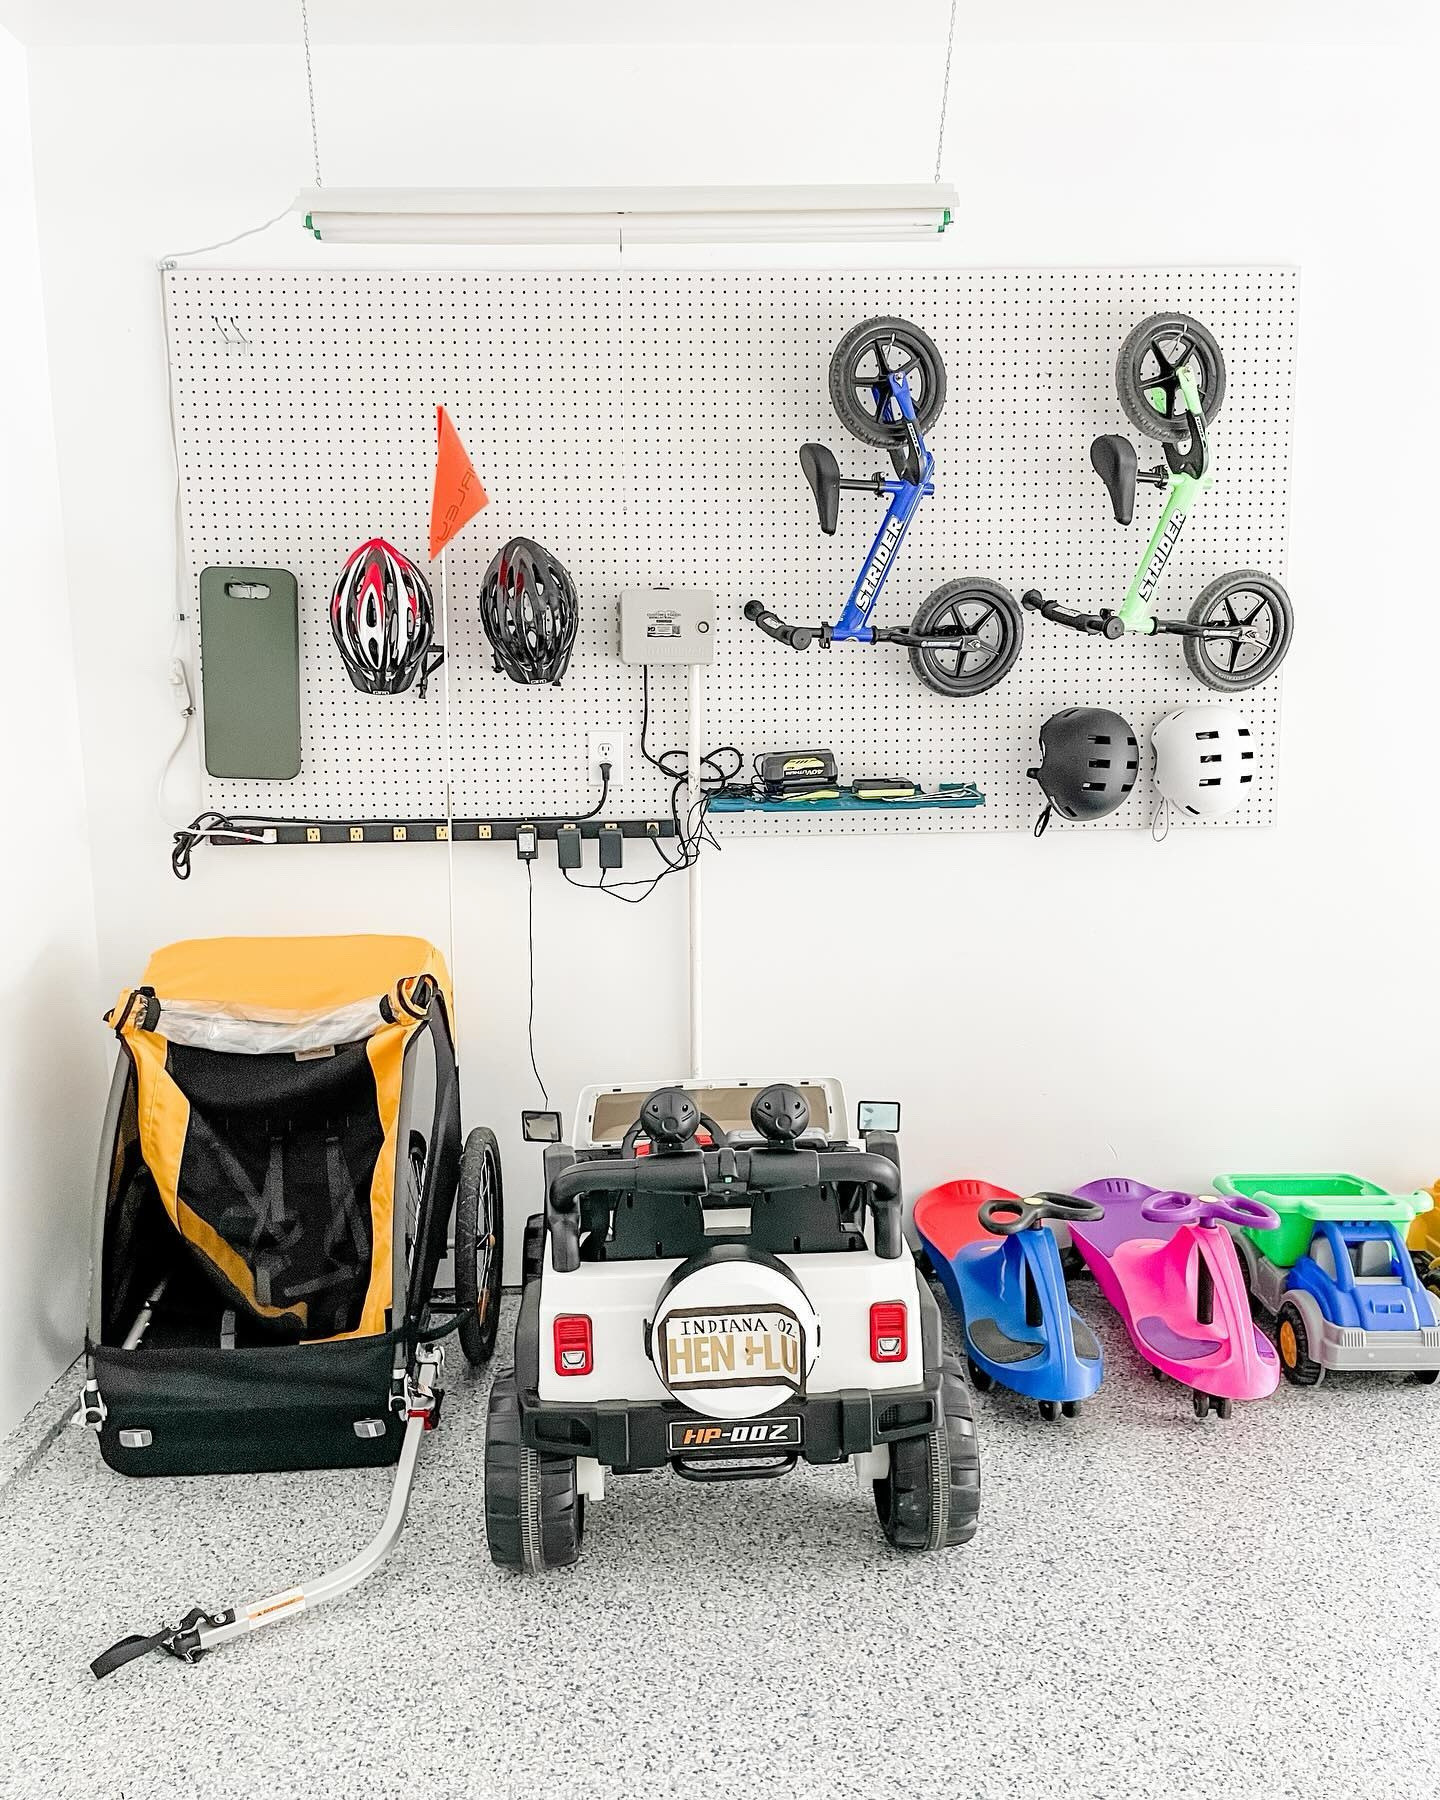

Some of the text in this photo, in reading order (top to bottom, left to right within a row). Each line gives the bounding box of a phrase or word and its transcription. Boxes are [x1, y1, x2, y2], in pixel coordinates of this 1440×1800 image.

[855, 515, 904, 613] STRIDER
[1138, 508, 1186, 602] STRIDER
[681, 1318, 768, 1335] INDIANA
